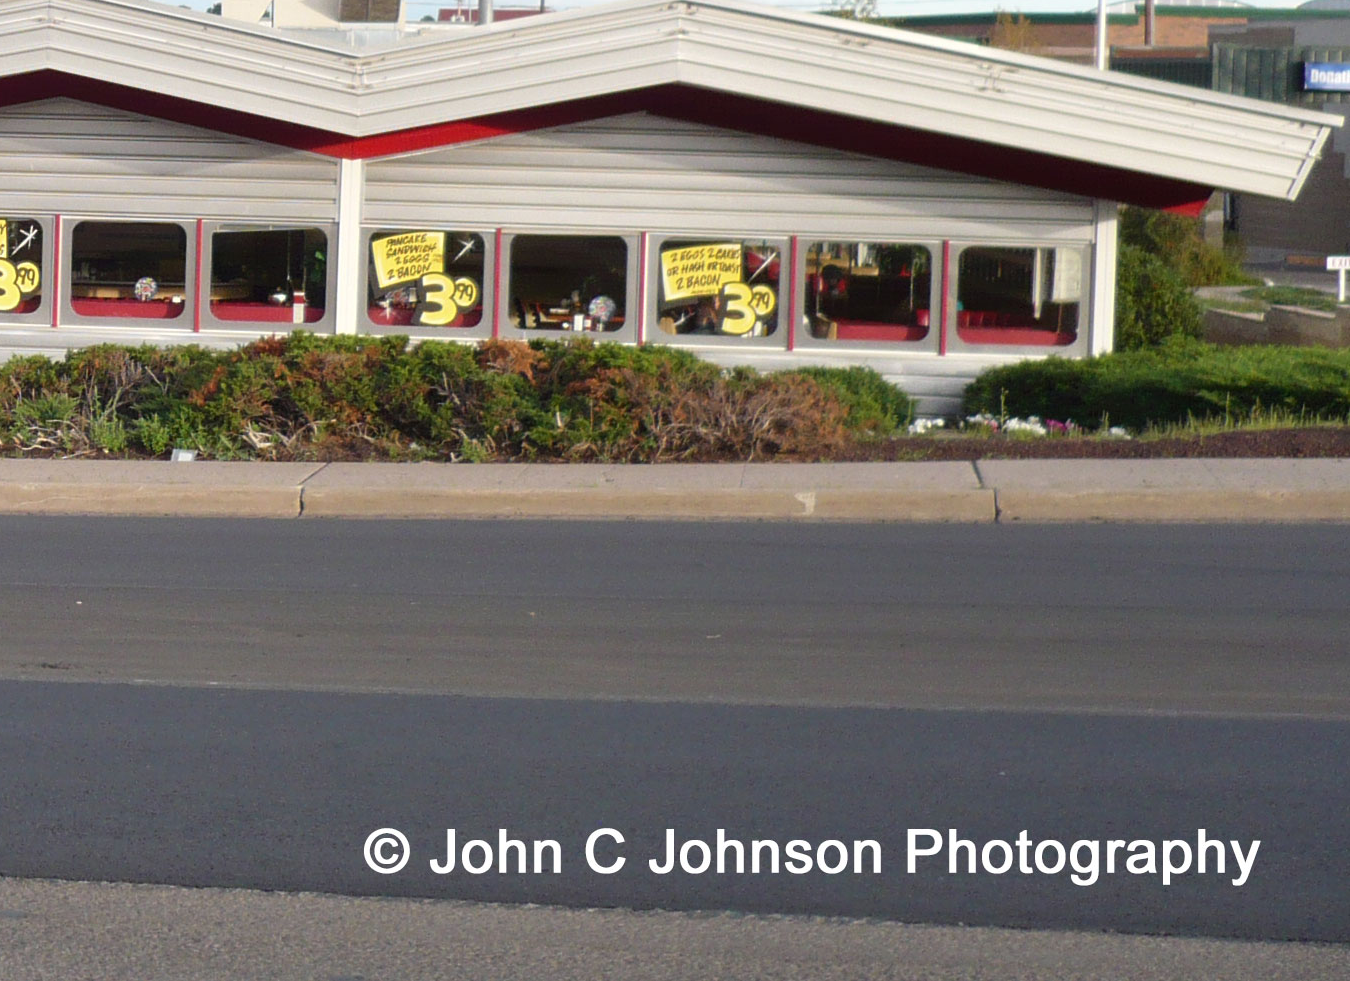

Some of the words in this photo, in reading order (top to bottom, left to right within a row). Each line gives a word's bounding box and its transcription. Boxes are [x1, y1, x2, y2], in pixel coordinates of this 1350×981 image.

[386, 233, 428, 248] PANCAKE
[386, 242, 437, 259] SANDWICH
[394, 255, 402, 265] 2
[403, 253, 430, 265] EGGS
[670, 252, 679, 262] 2
[680, 248, 706, 261] EGGS
[387, 269, 396, 279] 2
[397, 262, 432, 278] BACON
[666, 266, 679, 277] OR
[681, 261, 705, 274] HASH
[676, 277, 685, 290] 2
[686, 273, 721, 289] BACON
[420, 272, 457, 325] 3
[722, 282, 756, 334] 3
